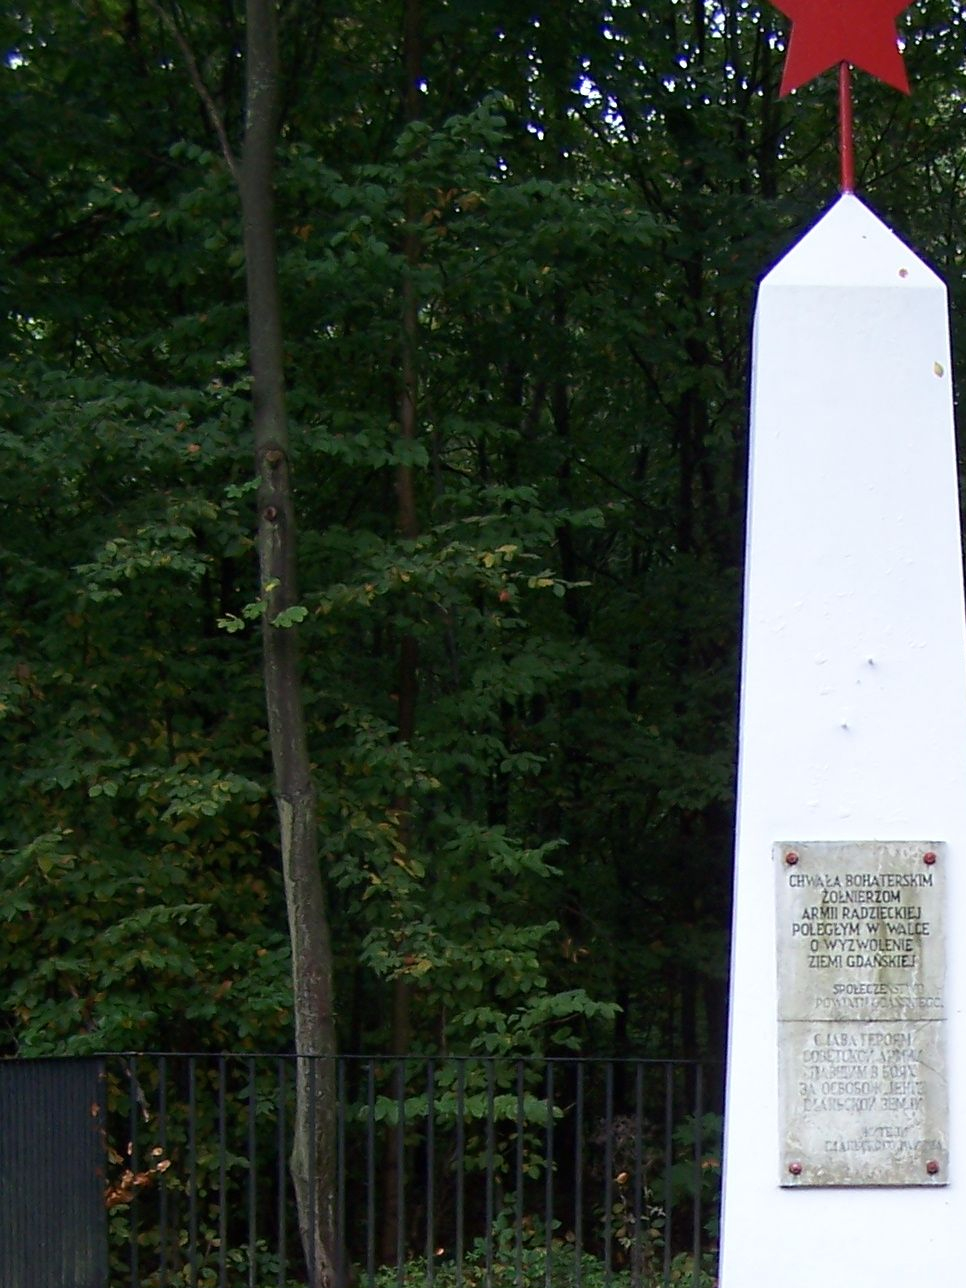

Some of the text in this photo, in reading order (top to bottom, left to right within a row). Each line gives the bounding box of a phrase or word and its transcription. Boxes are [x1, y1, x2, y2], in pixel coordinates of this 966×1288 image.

[789, 873, 934, 888] CHWAŁA BOHATERSKIM
[821, 888, 901, 904] ŻOŁNIERZOM
[801, 906, 922, 920] ARMII RADZIECKIEJ
[791, 923, 930, 937] POLEGŁYM W WALCE
[810, 939, 914, 952] O WYZWOLENIE
[807, 953, 916, 968] ZIEMI GDAŃSKIEJ
